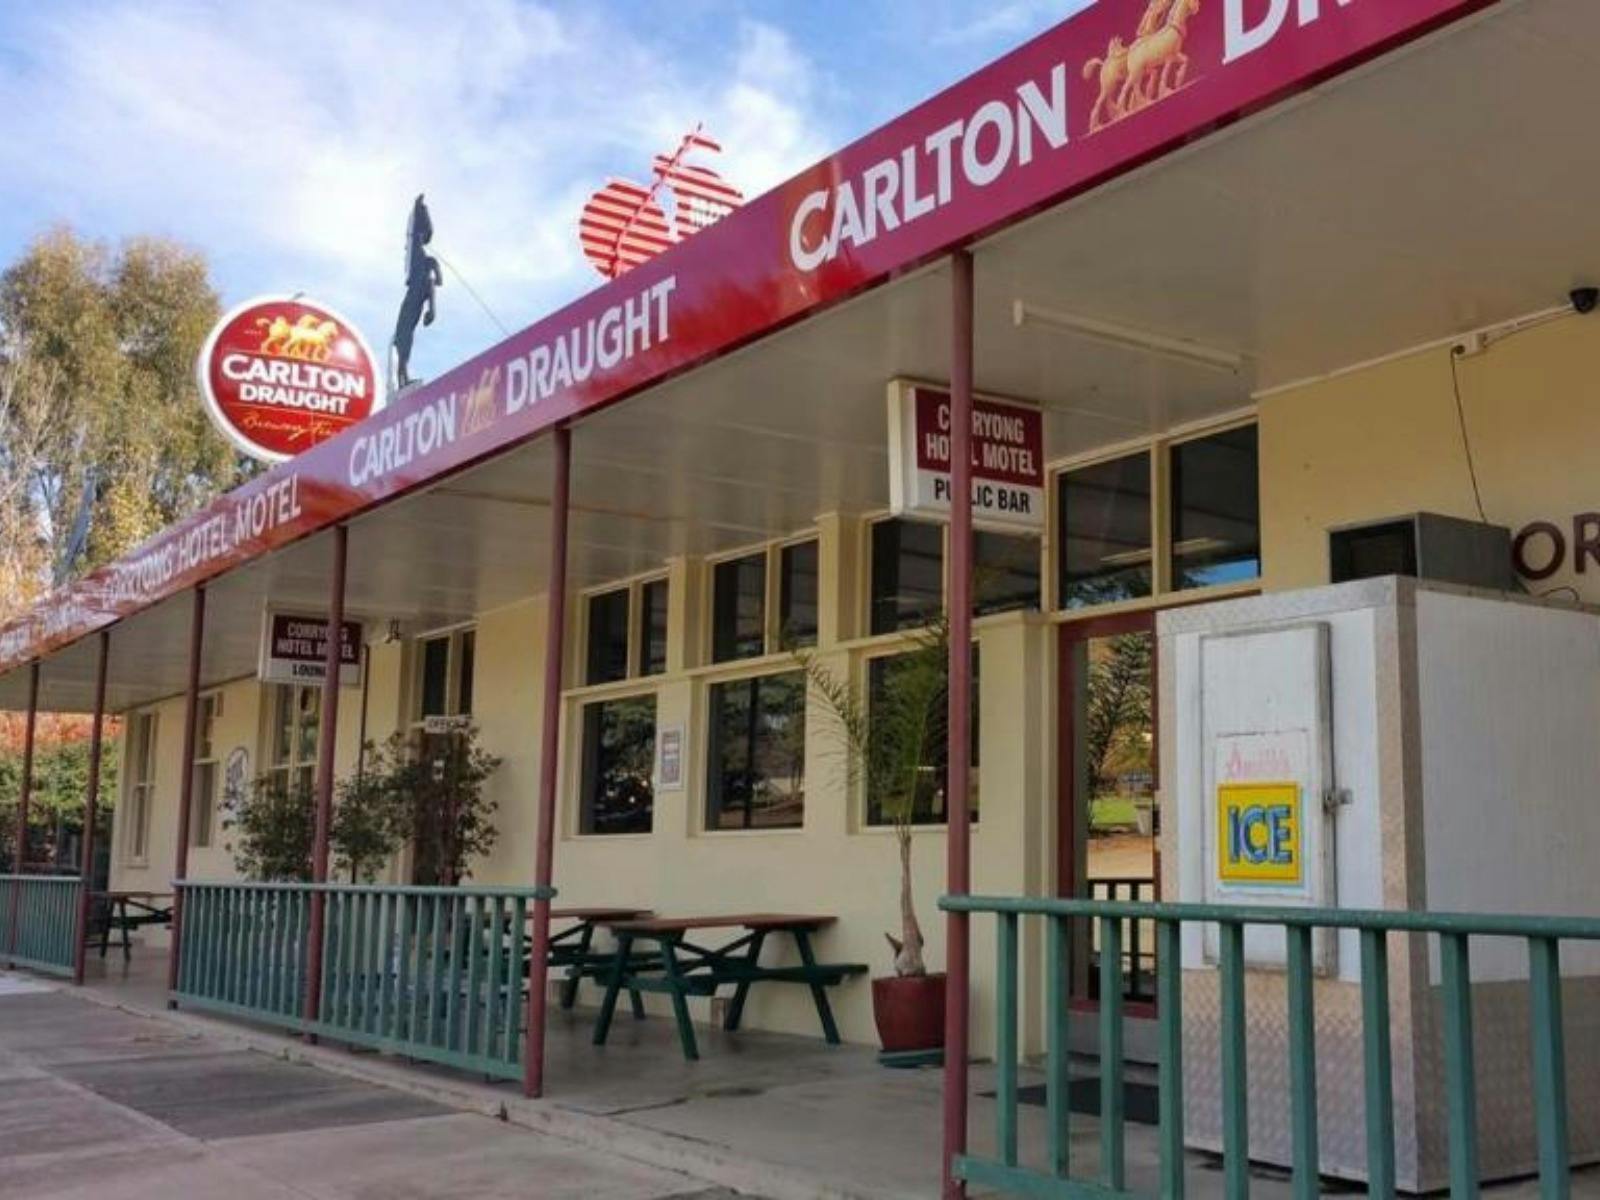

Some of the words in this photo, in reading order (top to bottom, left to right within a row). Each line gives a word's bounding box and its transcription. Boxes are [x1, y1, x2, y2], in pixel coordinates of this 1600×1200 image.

[789, 65, 1068, 271] CARLTON
[222, 354, 365, 399] CARLTON
[239, 382, 349, 415] DRAUGHT
[349, 393, 455, 486] CARLTON
[505, 275, 676, 415] DRAUGHT
[937, 403, 1024, 444] CRYONG
[925, 432, 979, 466] HOL
[982, 442, 1037, 476] MOTEL
[176, 513, 229, 573] HOTEL
[235, 473, 302, 546] MOTEL
[998, 490, 1031, 514] BAR
[316, 642, 354, 659] MEL
[1227, 804, 1294, 865] ICE
